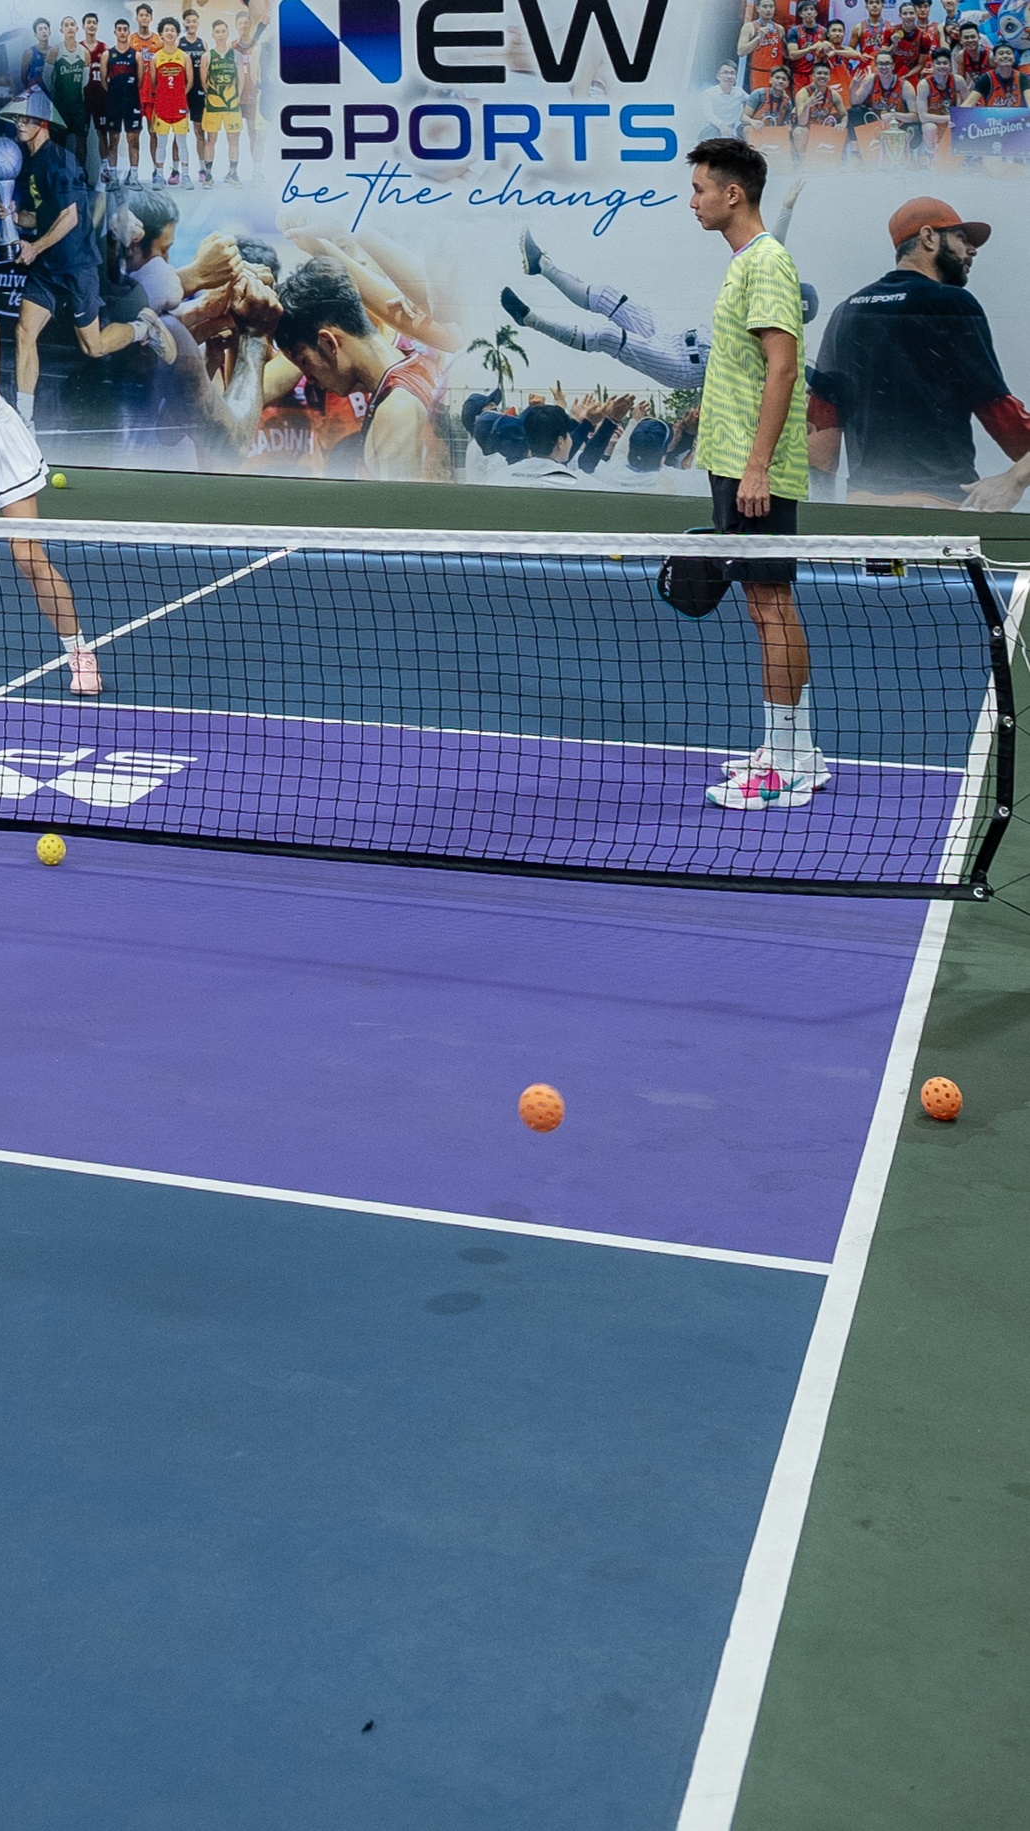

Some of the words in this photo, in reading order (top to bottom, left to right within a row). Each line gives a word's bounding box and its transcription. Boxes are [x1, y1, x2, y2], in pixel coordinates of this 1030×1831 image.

[167, 75, 174, 86] 2
[280, 104, 678, 163] SPORTS
[968, 121, 1023, 140] Champion
[281, 162, 349, 205] be
[345, 160, 452, 233] the
[468, 163, 678, 237] change
[850, 296, 871, 304] NEW
[871, 293, 907, 304] SPORTS
